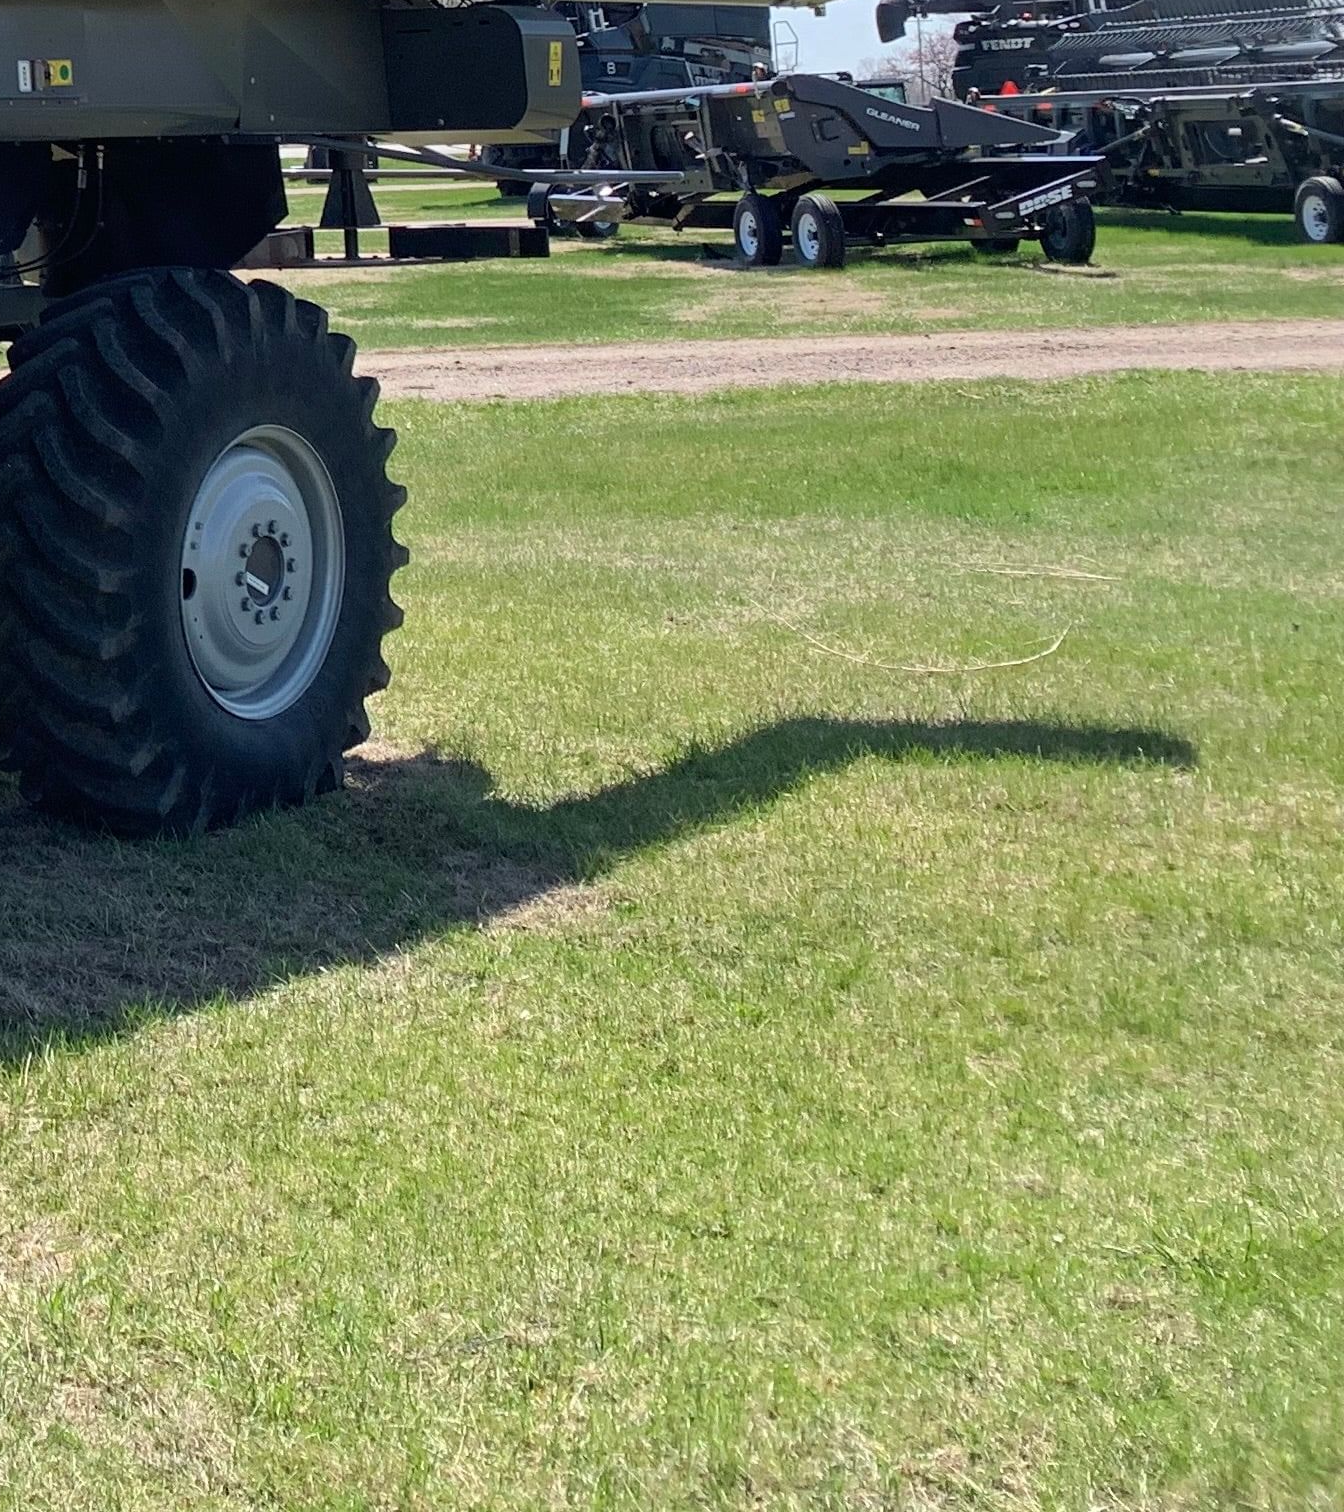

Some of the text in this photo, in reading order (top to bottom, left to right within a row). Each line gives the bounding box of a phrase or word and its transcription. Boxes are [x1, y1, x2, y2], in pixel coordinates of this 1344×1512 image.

[982, 37, 1035, 50] FENDT
[607, 62, 616, 75] 8
[866, 108, 921, 132] GLEANER
